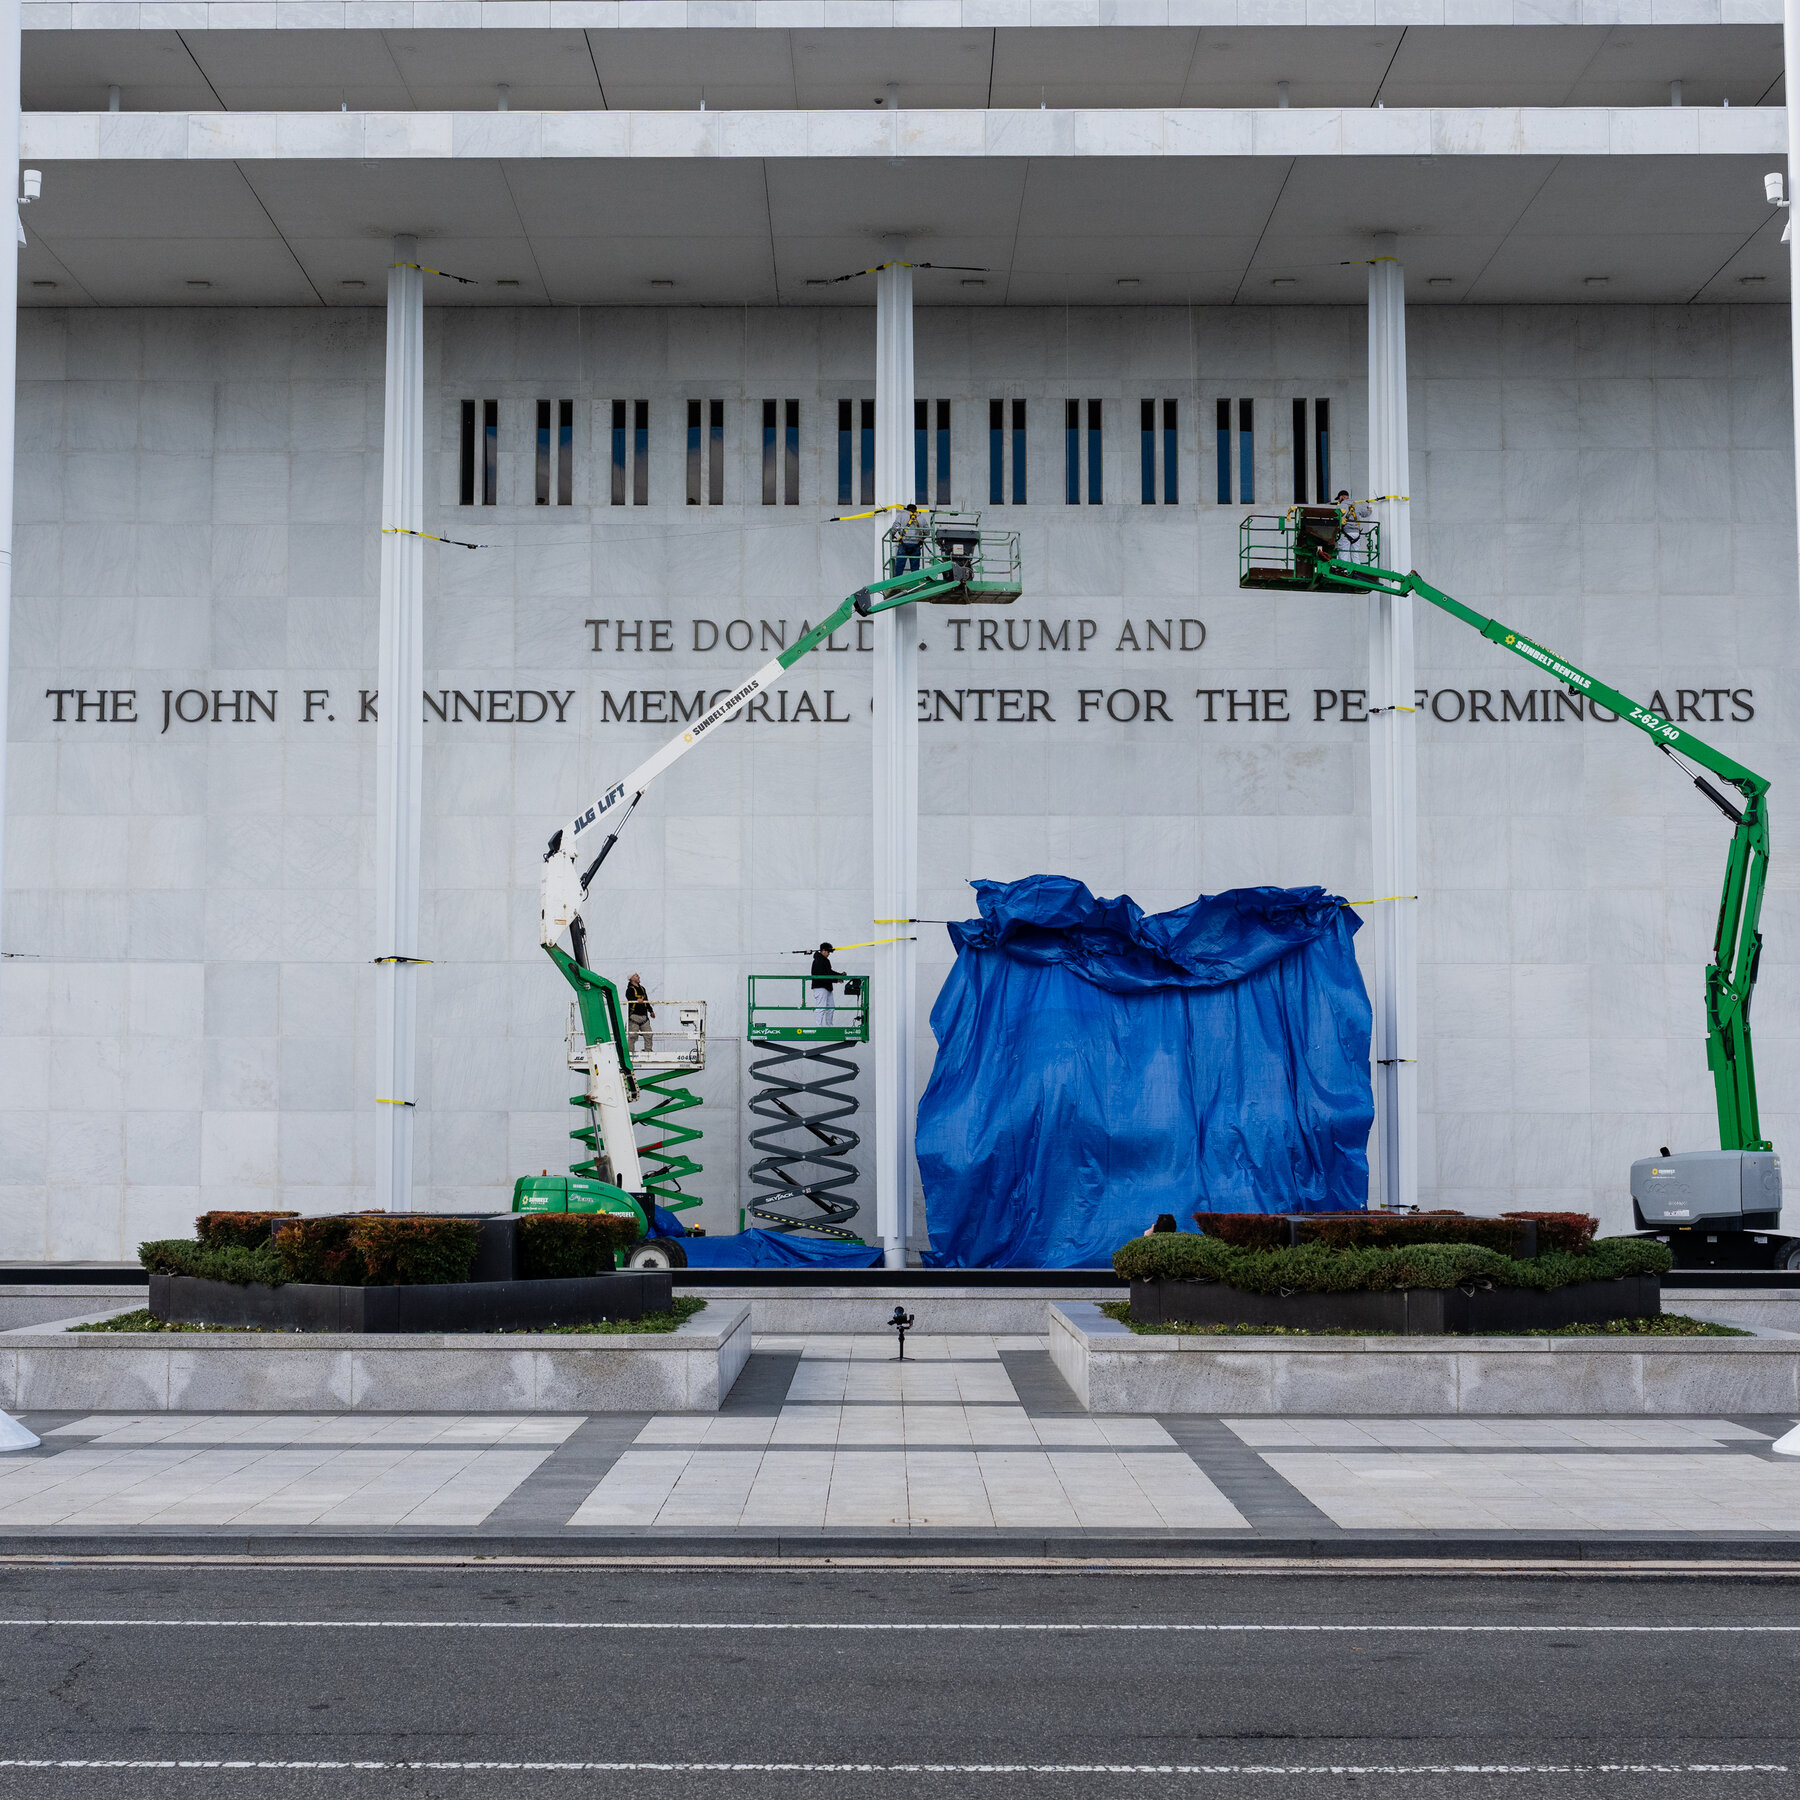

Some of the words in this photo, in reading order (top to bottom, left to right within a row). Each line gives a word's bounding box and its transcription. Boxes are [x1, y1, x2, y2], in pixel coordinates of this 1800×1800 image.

[585, 619, 673, 651] THE
[947, 618, 1097, 651] TRUMP
[1115, 618, 1207, 651] AND
[1515, 640, 1554, 667] SUNBELT
[1552, 661, 1592, 689] RENTALS
[46, 689, 137, 722] THE
[161, 689, 278, 734] JOHN
[303, 689, 335, 722] F.
[358, 690, 576, 722] KNNEDY
[1078, 689, 1174, 722] FOR
[1196, 689, 1289, 722] THE
[1648, 689, 1755, 722] ARTS
[1629, 706, 1680, 740] Z-62/40
[573, 807, 597, 835] JLG
[597, 782, 625, 814] LIFT
